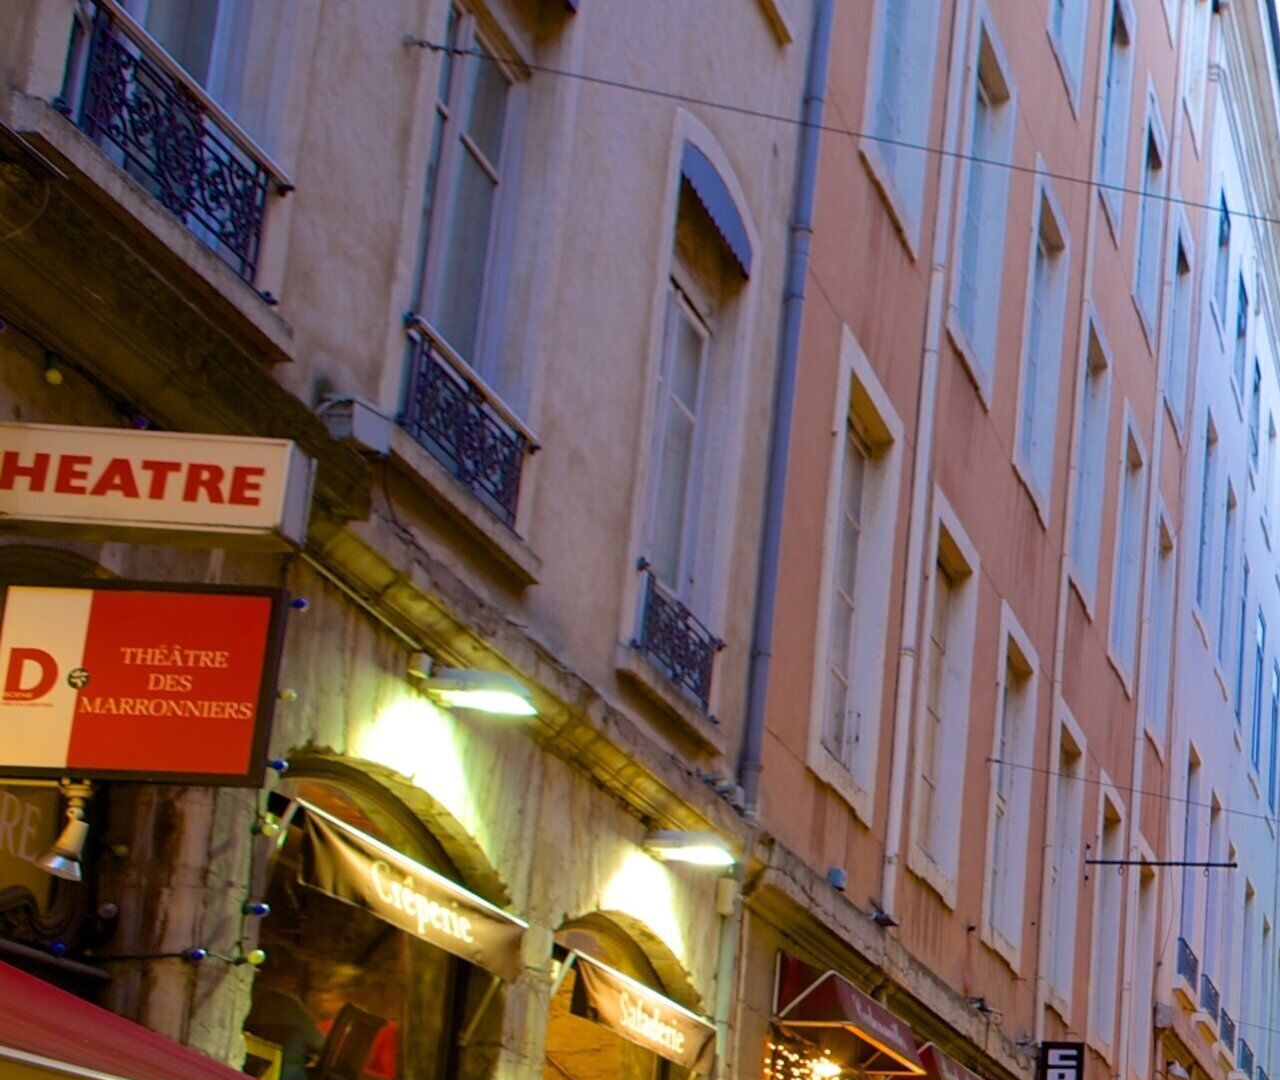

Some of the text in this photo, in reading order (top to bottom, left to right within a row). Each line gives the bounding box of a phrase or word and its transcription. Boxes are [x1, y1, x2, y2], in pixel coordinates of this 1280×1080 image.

[121, 645, 229, 668] THÉÂTRE
[149, 673, 193, 692] DES
[80, 696, 253, 719] MARRONNIERS
[369, 860, 474, 944] Crêperie
[620, 993, 684, 1054] Saladerie
